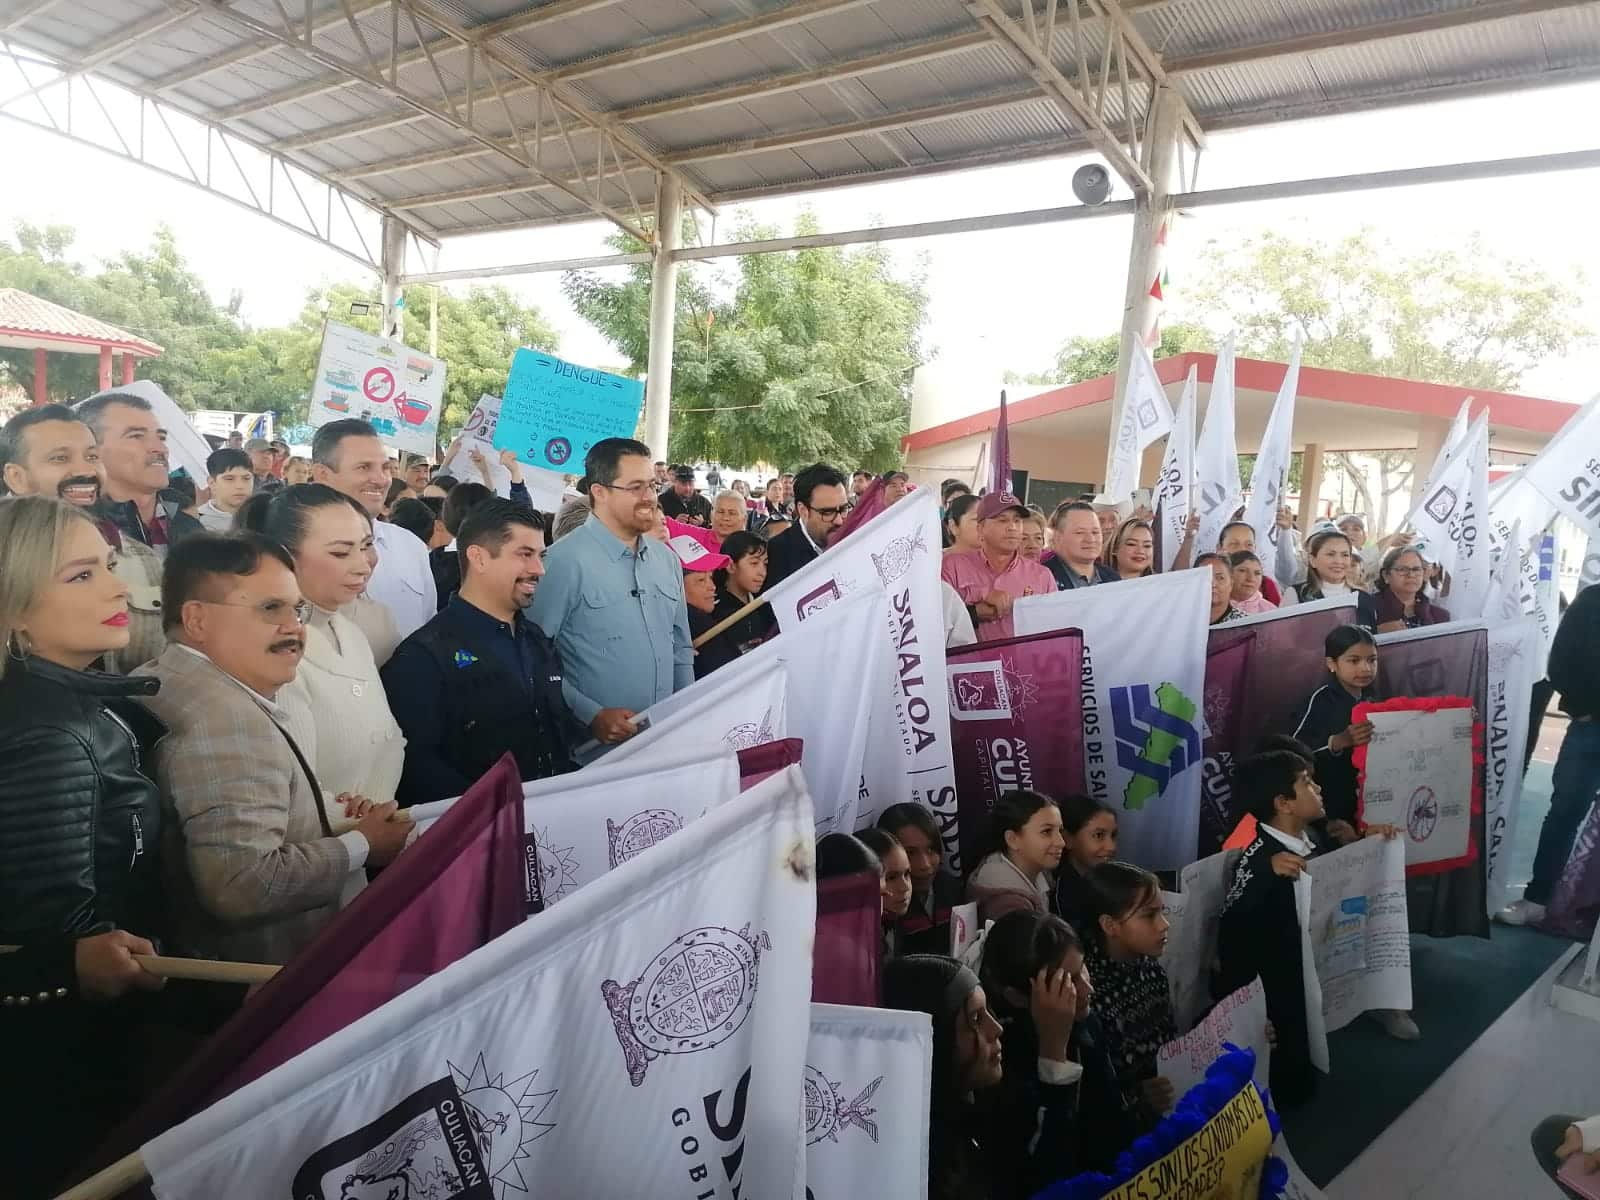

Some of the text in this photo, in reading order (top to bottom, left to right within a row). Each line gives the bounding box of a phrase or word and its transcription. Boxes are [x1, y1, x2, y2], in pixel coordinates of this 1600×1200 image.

[554, 360, 618, 387] DENGUE
[896, 704, 912, 756] ESTADO
[1088, 741, 1103, 764] DE
[526, 845, 539, 901] CULIACAN
[1245, 1084, 1263, 1124] DE
[440, 1099, 482, 1188] CULIACAN
